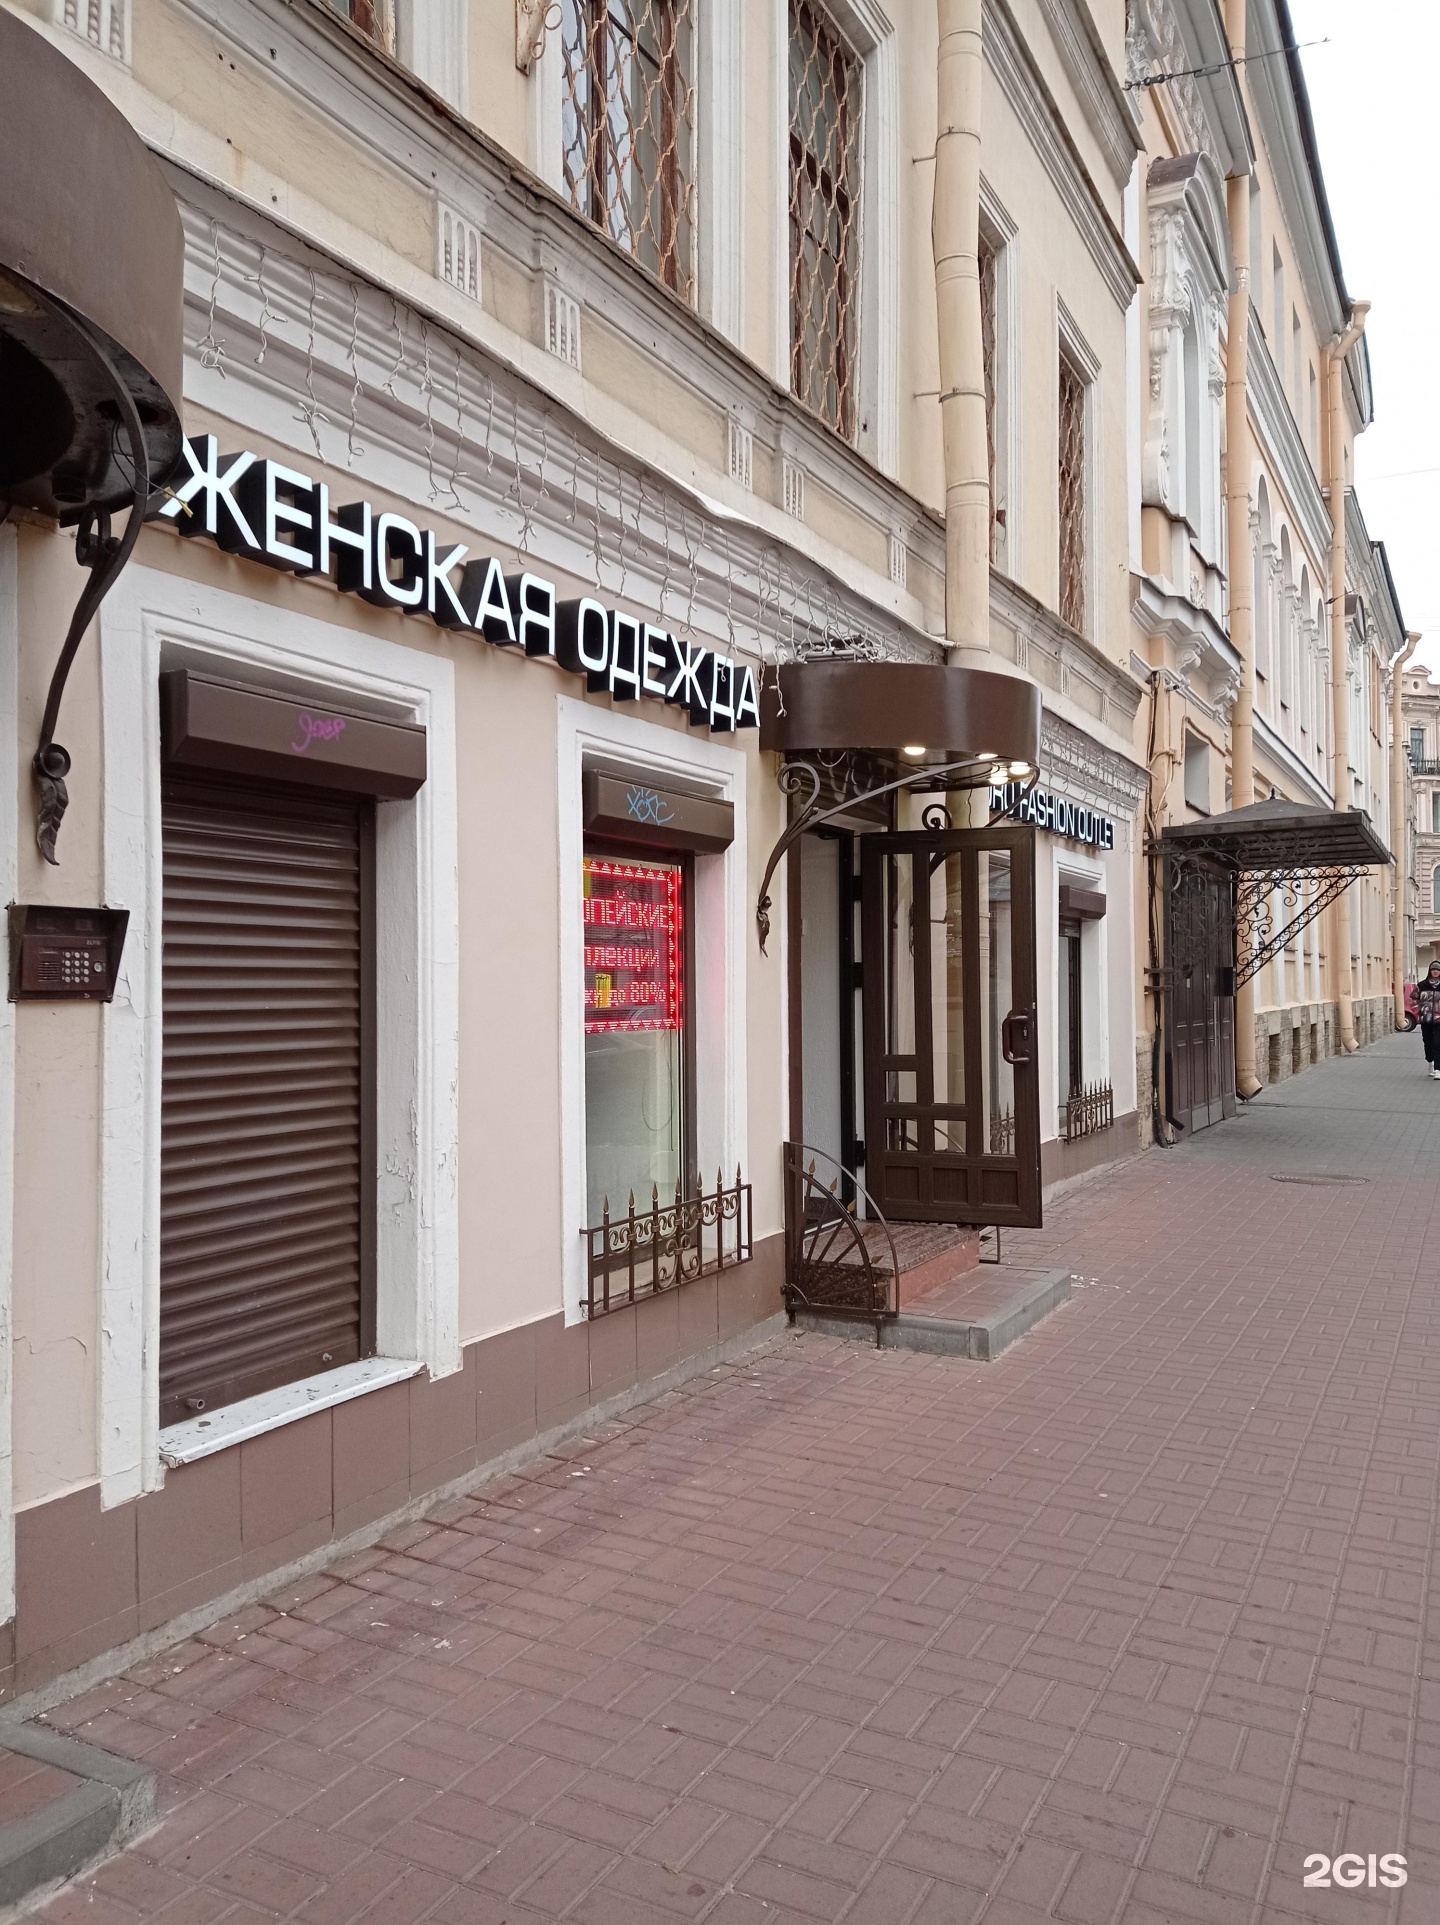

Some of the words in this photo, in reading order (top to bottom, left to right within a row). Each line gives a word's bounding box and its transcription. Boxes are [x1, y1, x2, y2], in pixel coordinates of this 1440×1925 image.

[158, 431, 555, 656] ЖЕНСКАЯ
[577, 597, 761, 732] ОДЕЖДА
[1020, 781, 1075, 837] FASHION
[1078, 806, 1116, 850] OUTLET
[630, 981, 666, 1003] 80%
